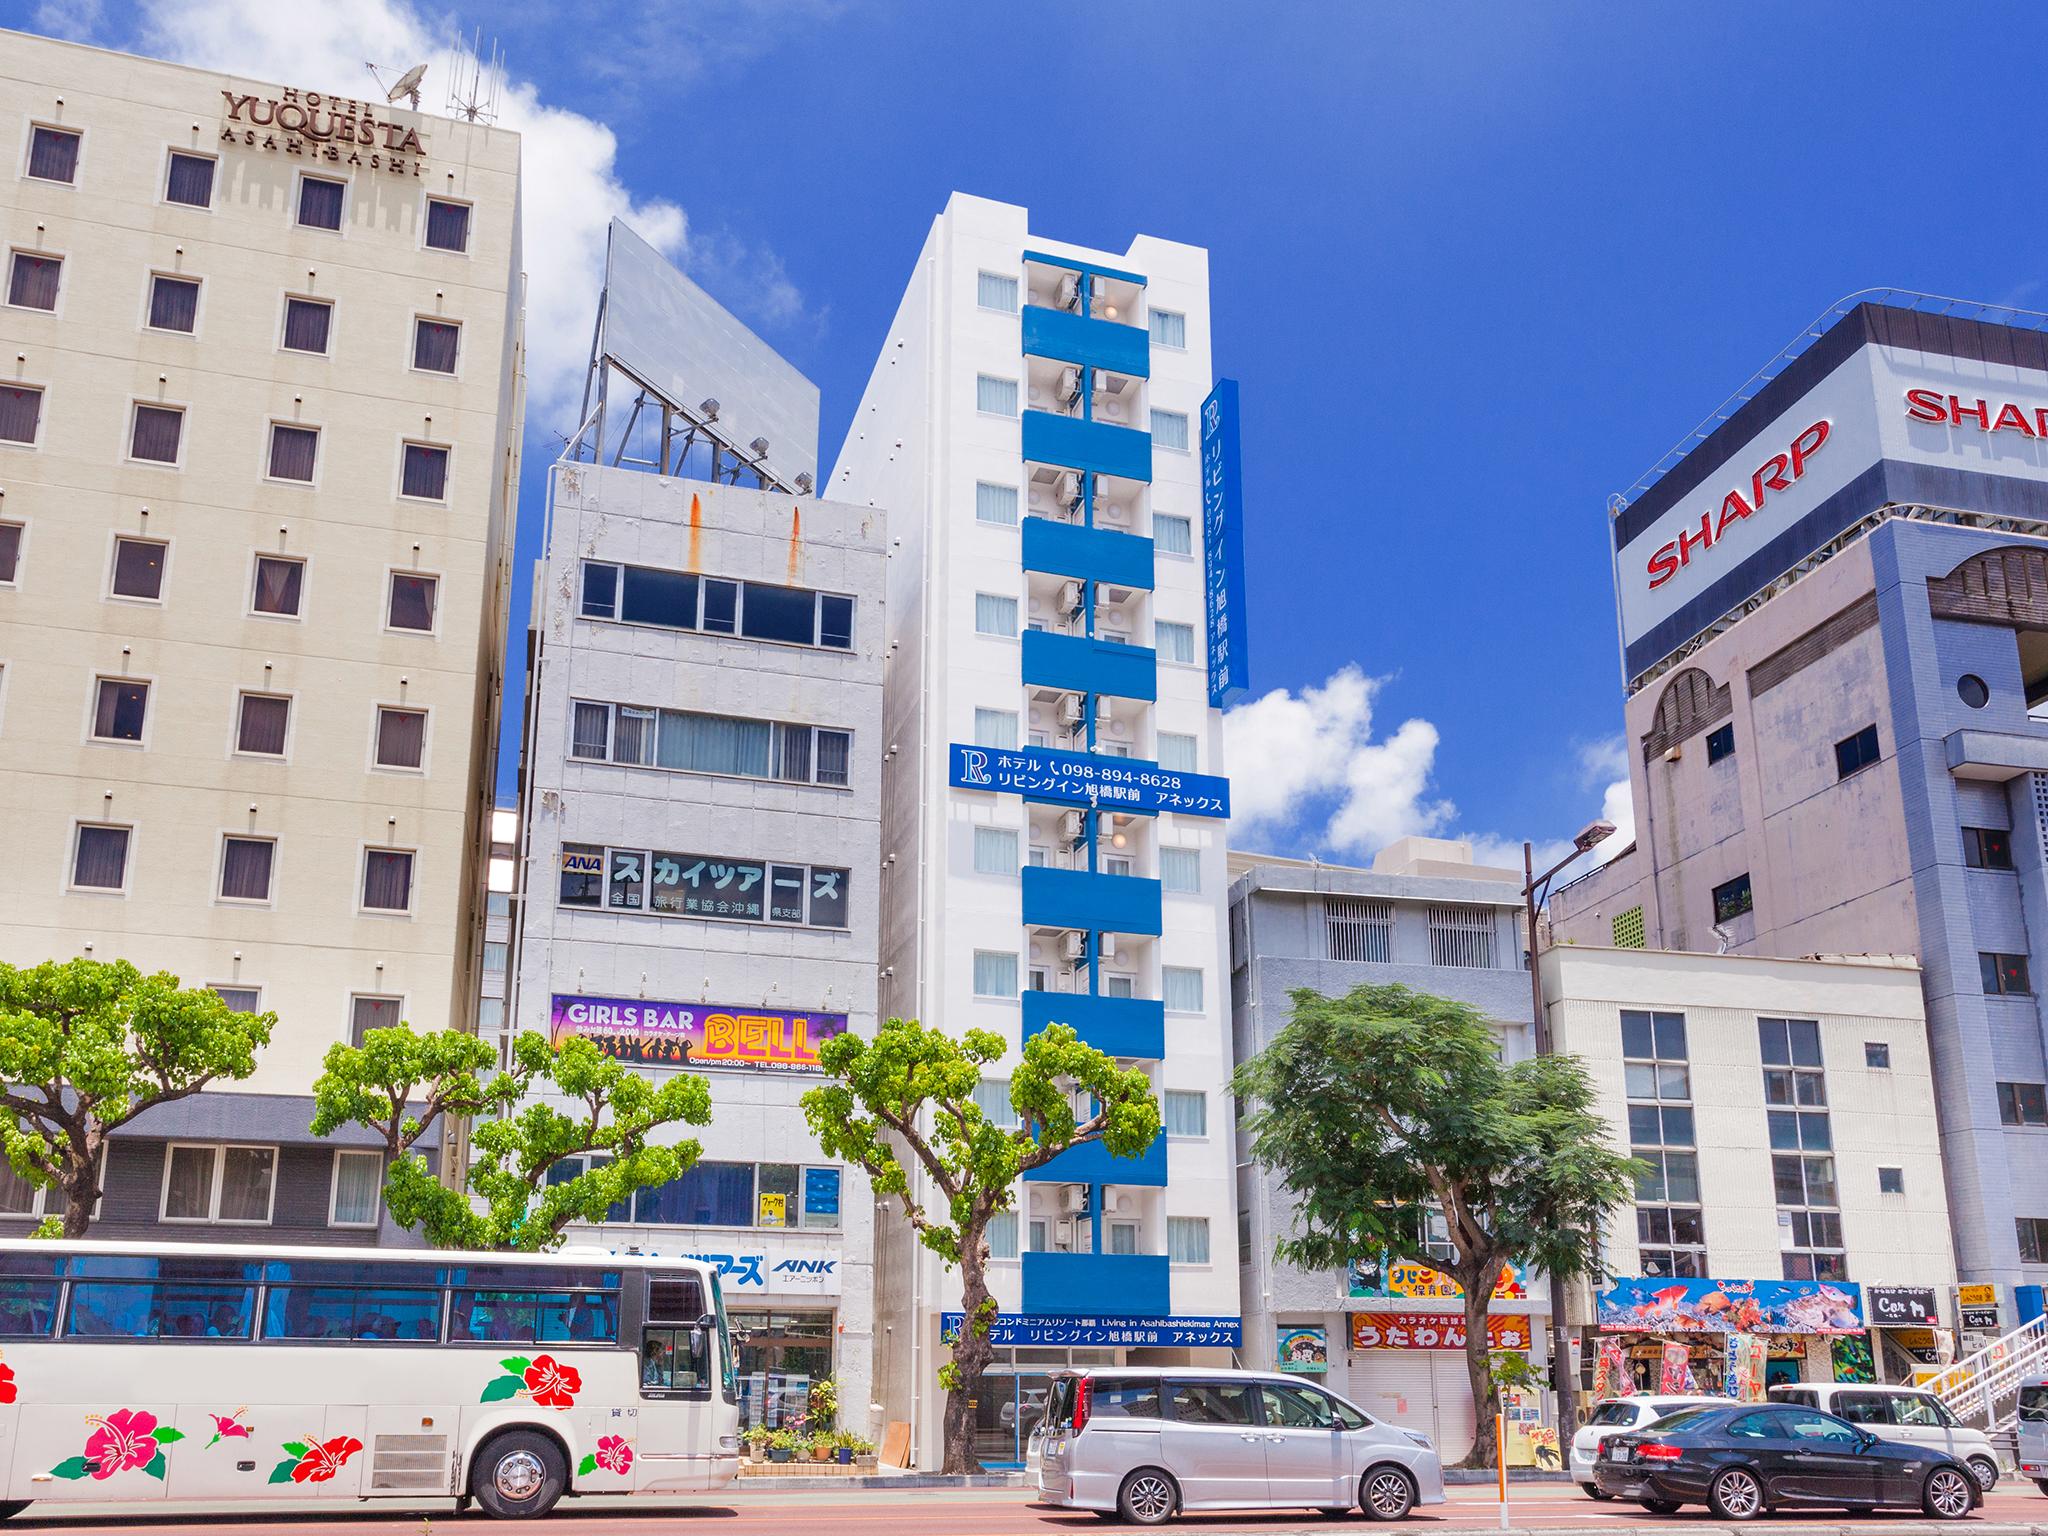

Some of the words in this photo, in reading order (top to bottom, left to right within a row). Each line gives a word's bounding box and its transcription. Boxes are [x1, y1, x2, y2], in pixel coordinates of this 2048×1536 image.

[283, 86, 373, 118] HOTEL
[221, 90, 427, 156] YUQUESTA
[221, 127, 421, 177] ASAHIBASHI
[1646, 418, 1832, 591] SHARP
[1212, 439, 1230, 691] リビングイン旭橋駅前
[998, 755, 1041, 773] ホテル
[1062, 763, 1182, 790] 098-894-8628
[998, 773, 1141, 802] リビングイン旭橋駅前
[1155, 792, 1224, 812] アネックス
[564, 855, 601, 871] ANA
[614, 856, 841, 900] スカイツアーズ
[567, 1003, 638, 1027] GIRLS
[643, 1008, 694, 1031] BAR
[704, 1014, 819, 1060] BELL
[771, 1259, 838, 1274] ANK
[989, 1329, 1016, 1341] テル
[1029, 1330, 1158, 1343] リビングイン旭橋駅前
[1172, 1331, 1234, 1344] アネックス
[994, 1318, 1097, 1328] コンドミニアムリゾート那覇
[1101, 1319, 1127, 1328] Living
[1129, 1319, 1138, 1327] in
[1213, 1320, 1240, 1329] Annex
